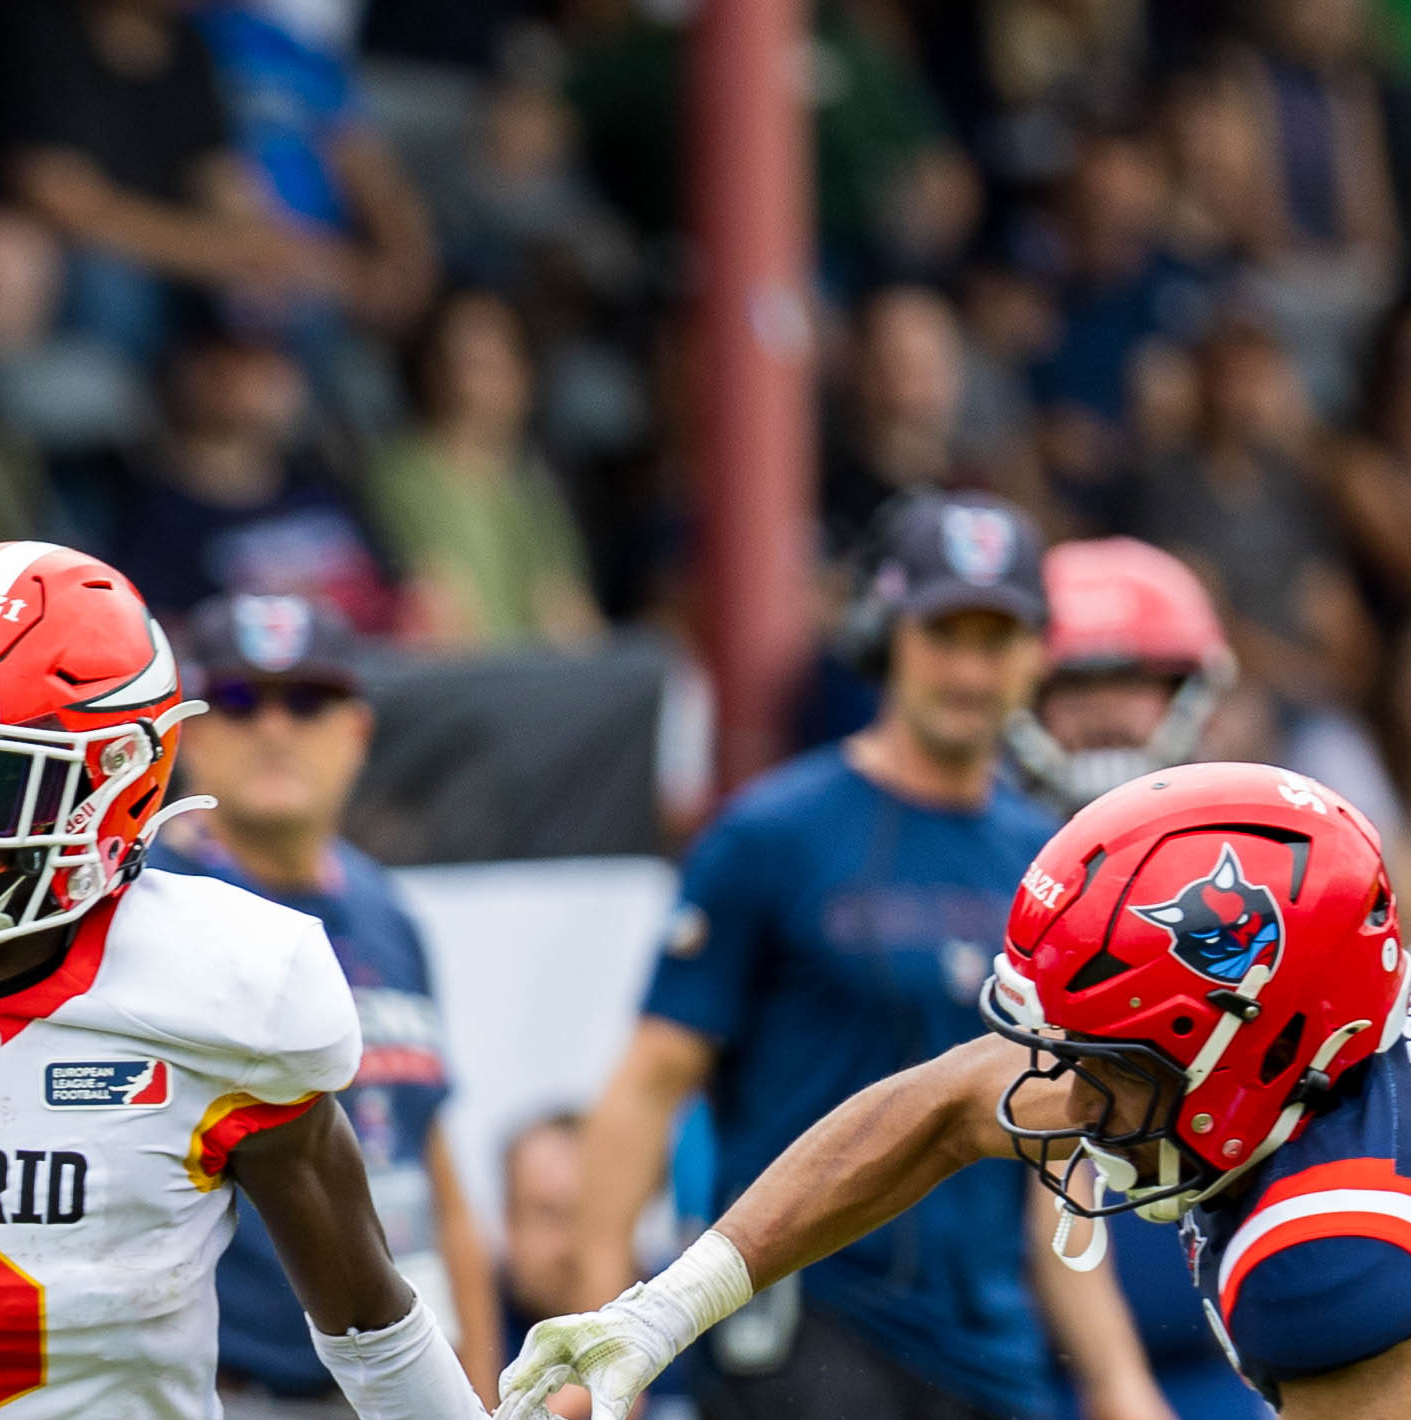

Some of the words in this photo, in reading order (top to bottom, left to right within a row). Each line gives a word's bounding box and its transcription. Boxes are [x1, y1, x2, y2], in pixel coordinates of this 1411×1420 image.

[52, 1067, 115, 1078] EUROPEAN
[52, 1079, 96, 1089] LEAGUE
[52, 1090, 112, 1100] FOOTBALL
